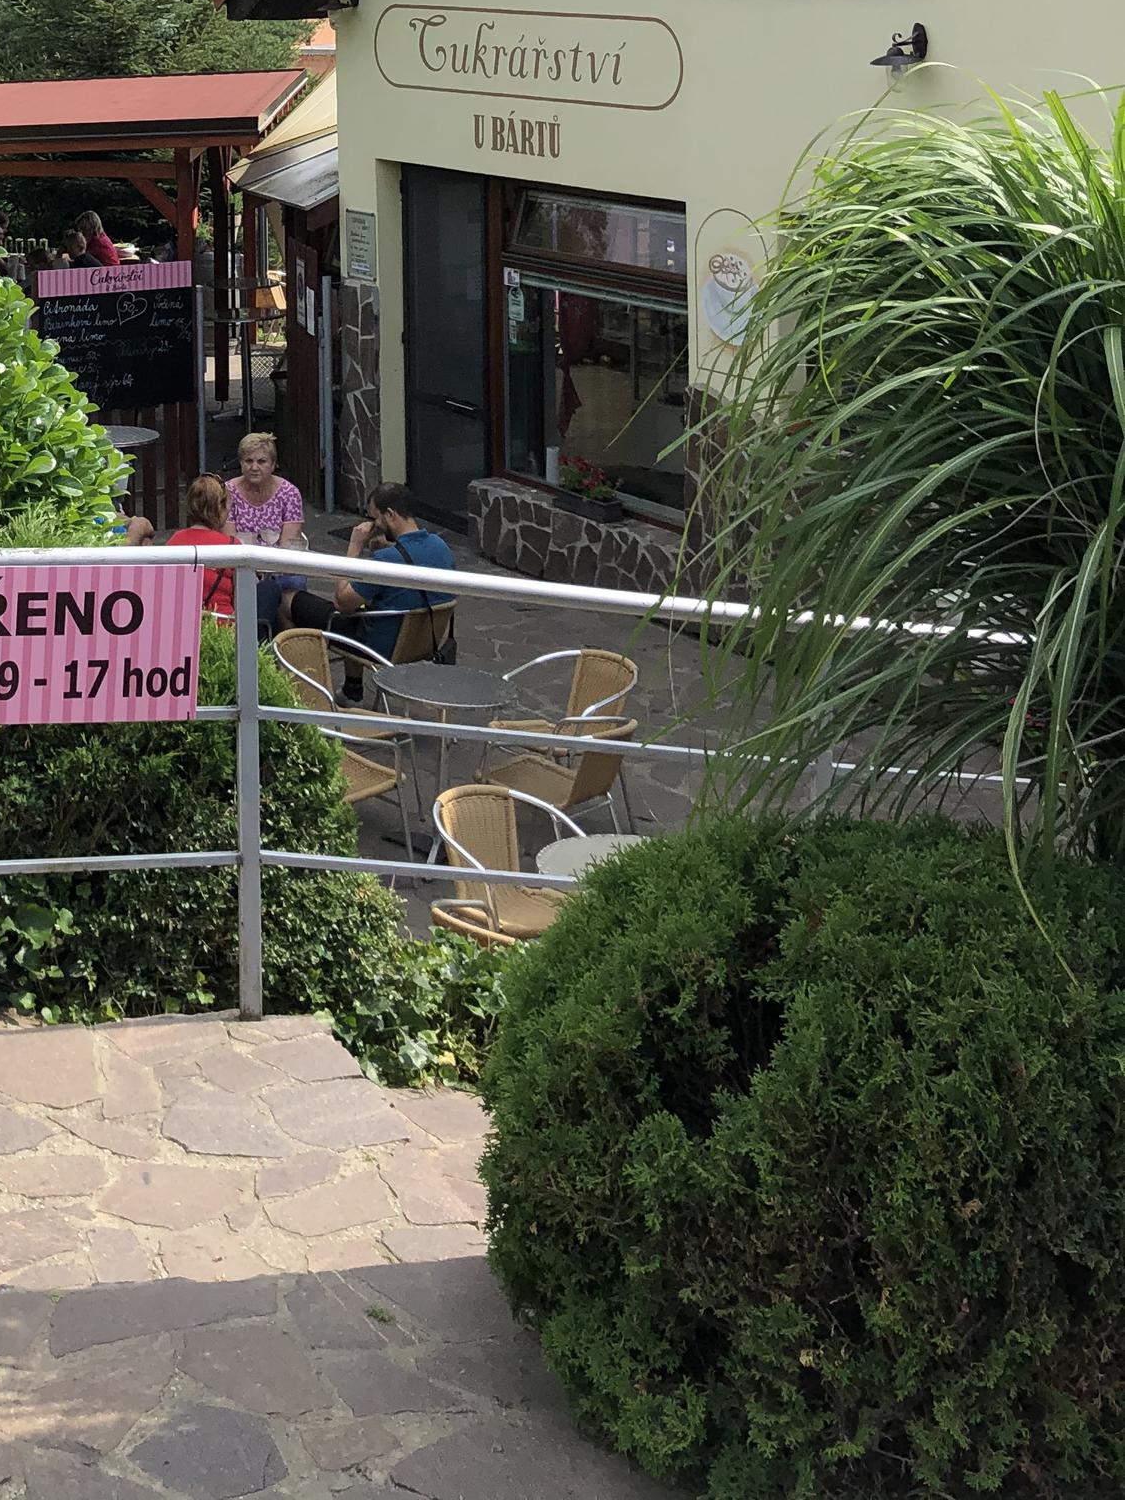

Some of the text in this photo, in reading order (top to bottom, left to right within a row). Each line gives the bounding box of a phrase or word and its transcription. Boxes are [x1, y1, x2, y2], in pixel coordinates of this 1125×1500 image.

[409, 14, 626, 85] Cukrářství
[473, 110, 561, 158] U BÁRTŮ
[43, 298, 98, 315] Citronáda
[63, 659, 109, 699] 17
[123, 656, 191, 697] hod
